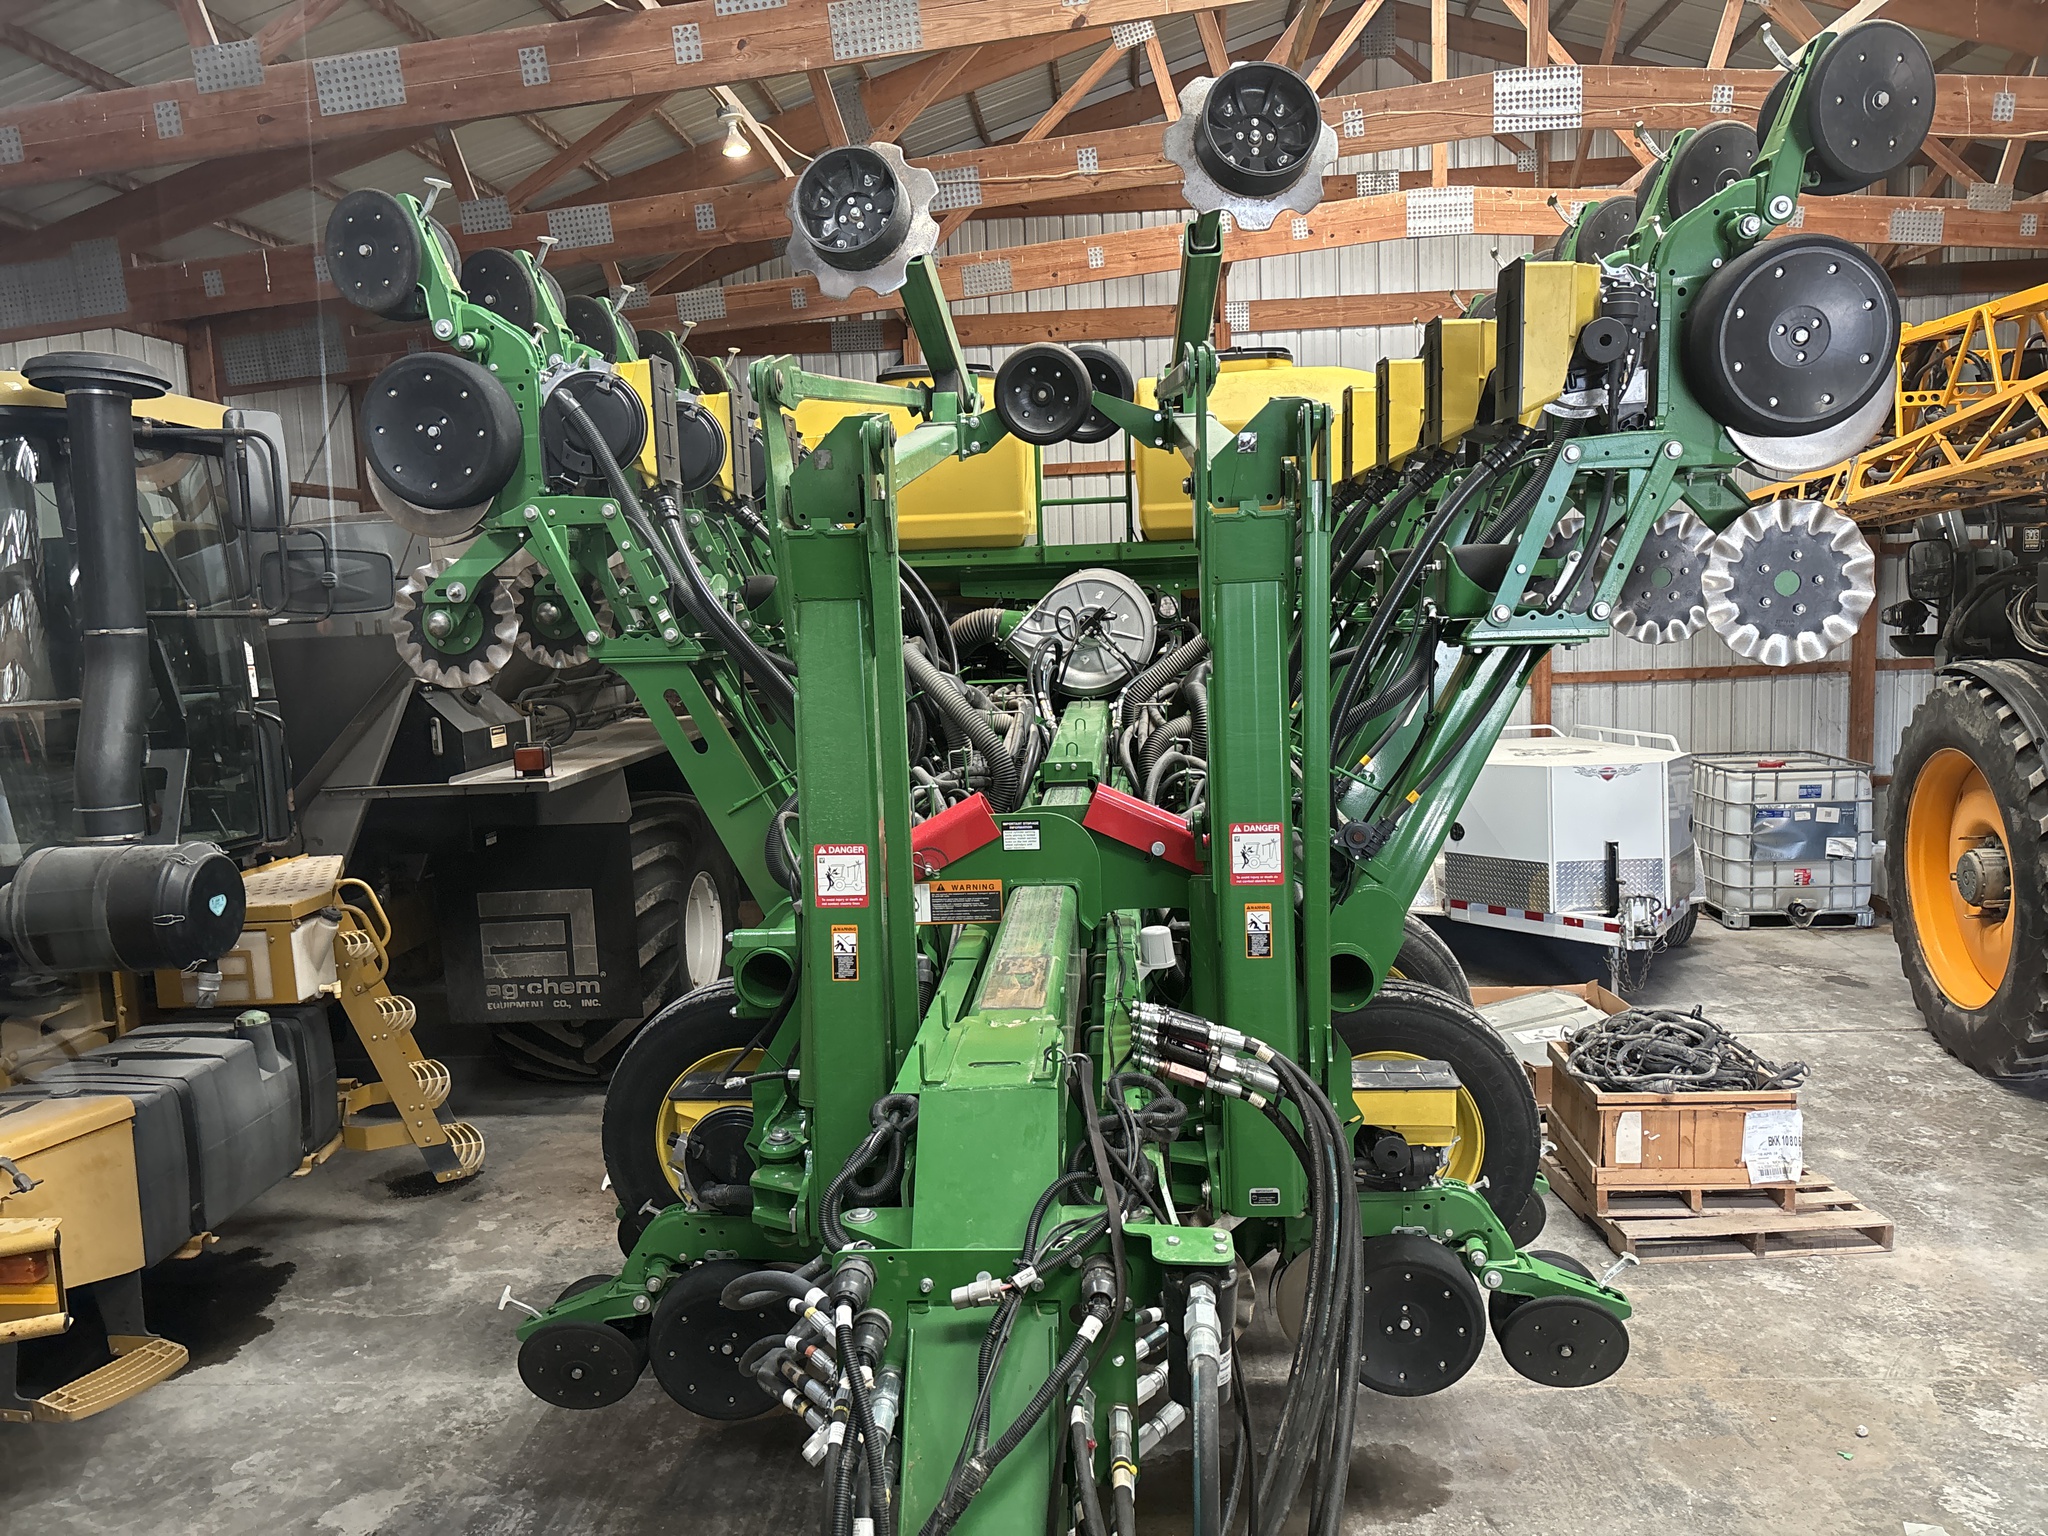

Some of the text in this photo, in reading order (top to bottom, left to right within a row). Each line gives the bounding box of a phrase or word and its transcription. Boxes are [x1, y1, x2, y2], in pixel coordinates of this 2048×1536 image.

[828, 846, 864, 854] DANGER
[487, 999, 602, 1010] EQUIPMENT CO., INC.
[1768, 1135, 1781, 1147] BKK
